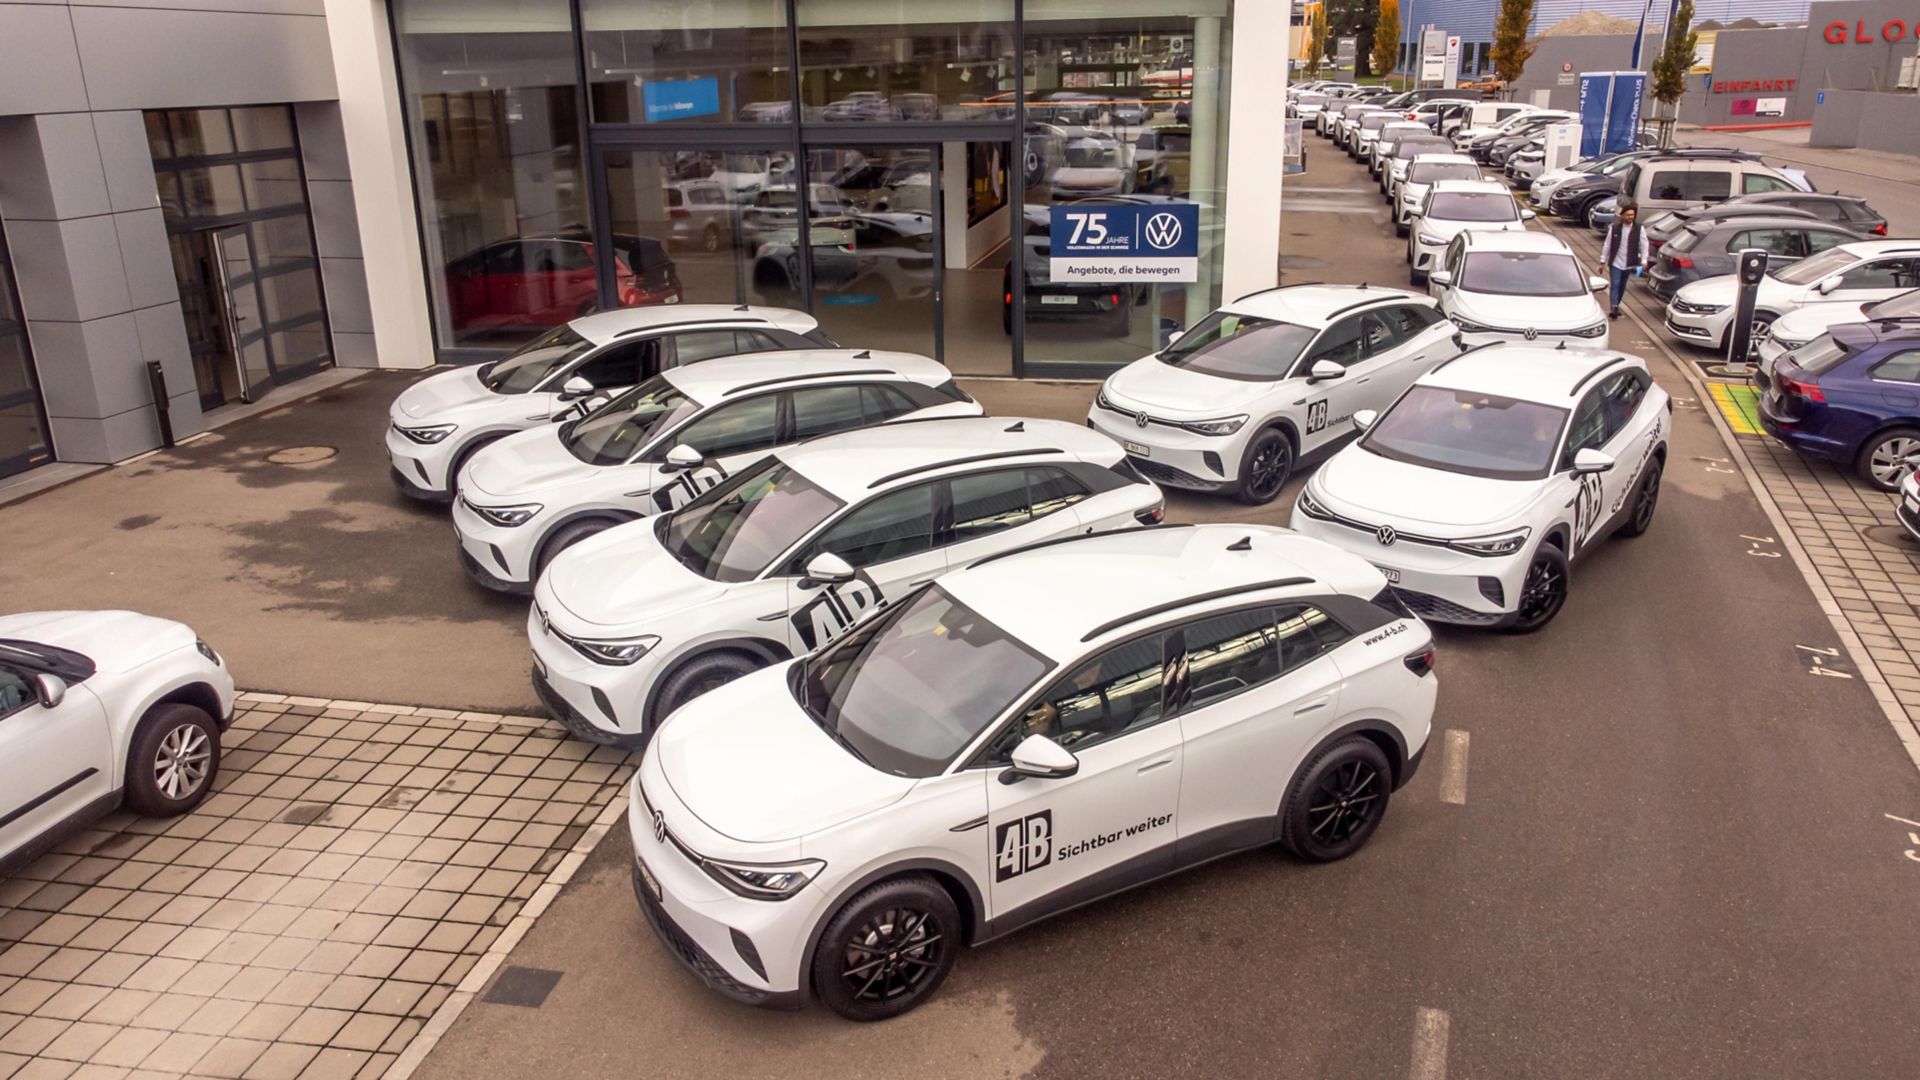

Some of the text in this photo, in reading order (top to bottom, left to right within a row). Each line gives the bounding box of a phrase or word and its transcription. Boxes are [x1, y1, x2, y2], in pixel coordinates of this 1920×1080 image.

[1824, 19, 1920, 44] GLO
[1634, 79, 1642, 98] PLUS
[1714, 78, 1796, 93] EINFAHRT
[1066, 213, 1129, 244] 75 JAHRE
[1067, 266, 1180, 276] Angebote, die bewegen
[1363, 622, 1408, 646] www.4-b.ch
[999, 813, 1172, 875] 4B Sichtbar weiter
